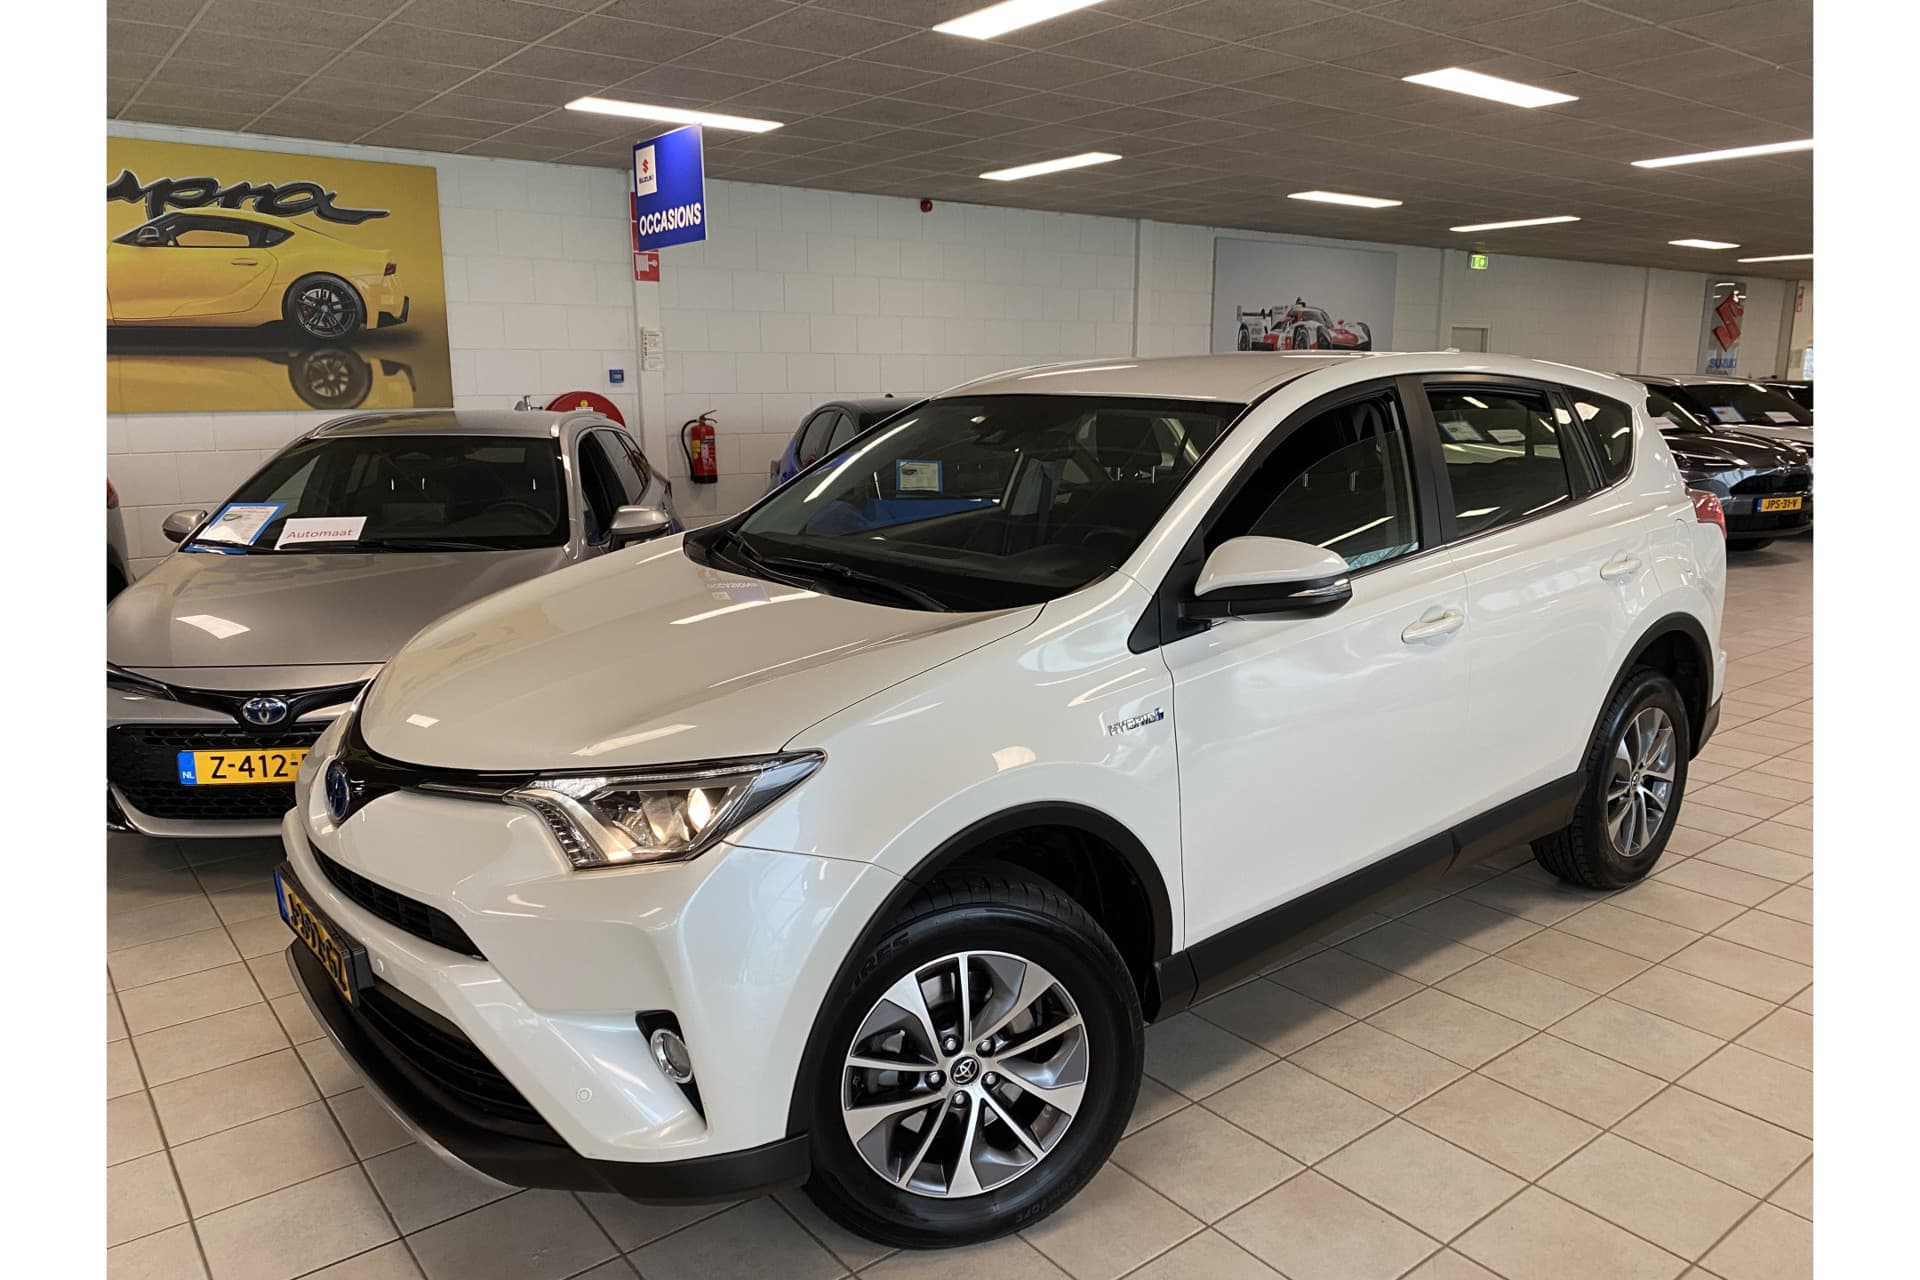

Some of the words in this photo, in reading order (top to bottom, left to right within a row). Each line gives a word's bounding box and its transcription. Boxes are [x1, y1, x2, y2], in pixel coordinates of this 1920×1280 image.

[639, 202, 702, 236] OCCASIONS
[286, 528, 353, 540] Automaat
[182, 771, 195, 780] NL
[209, 753, 307, 780] Z-412-
